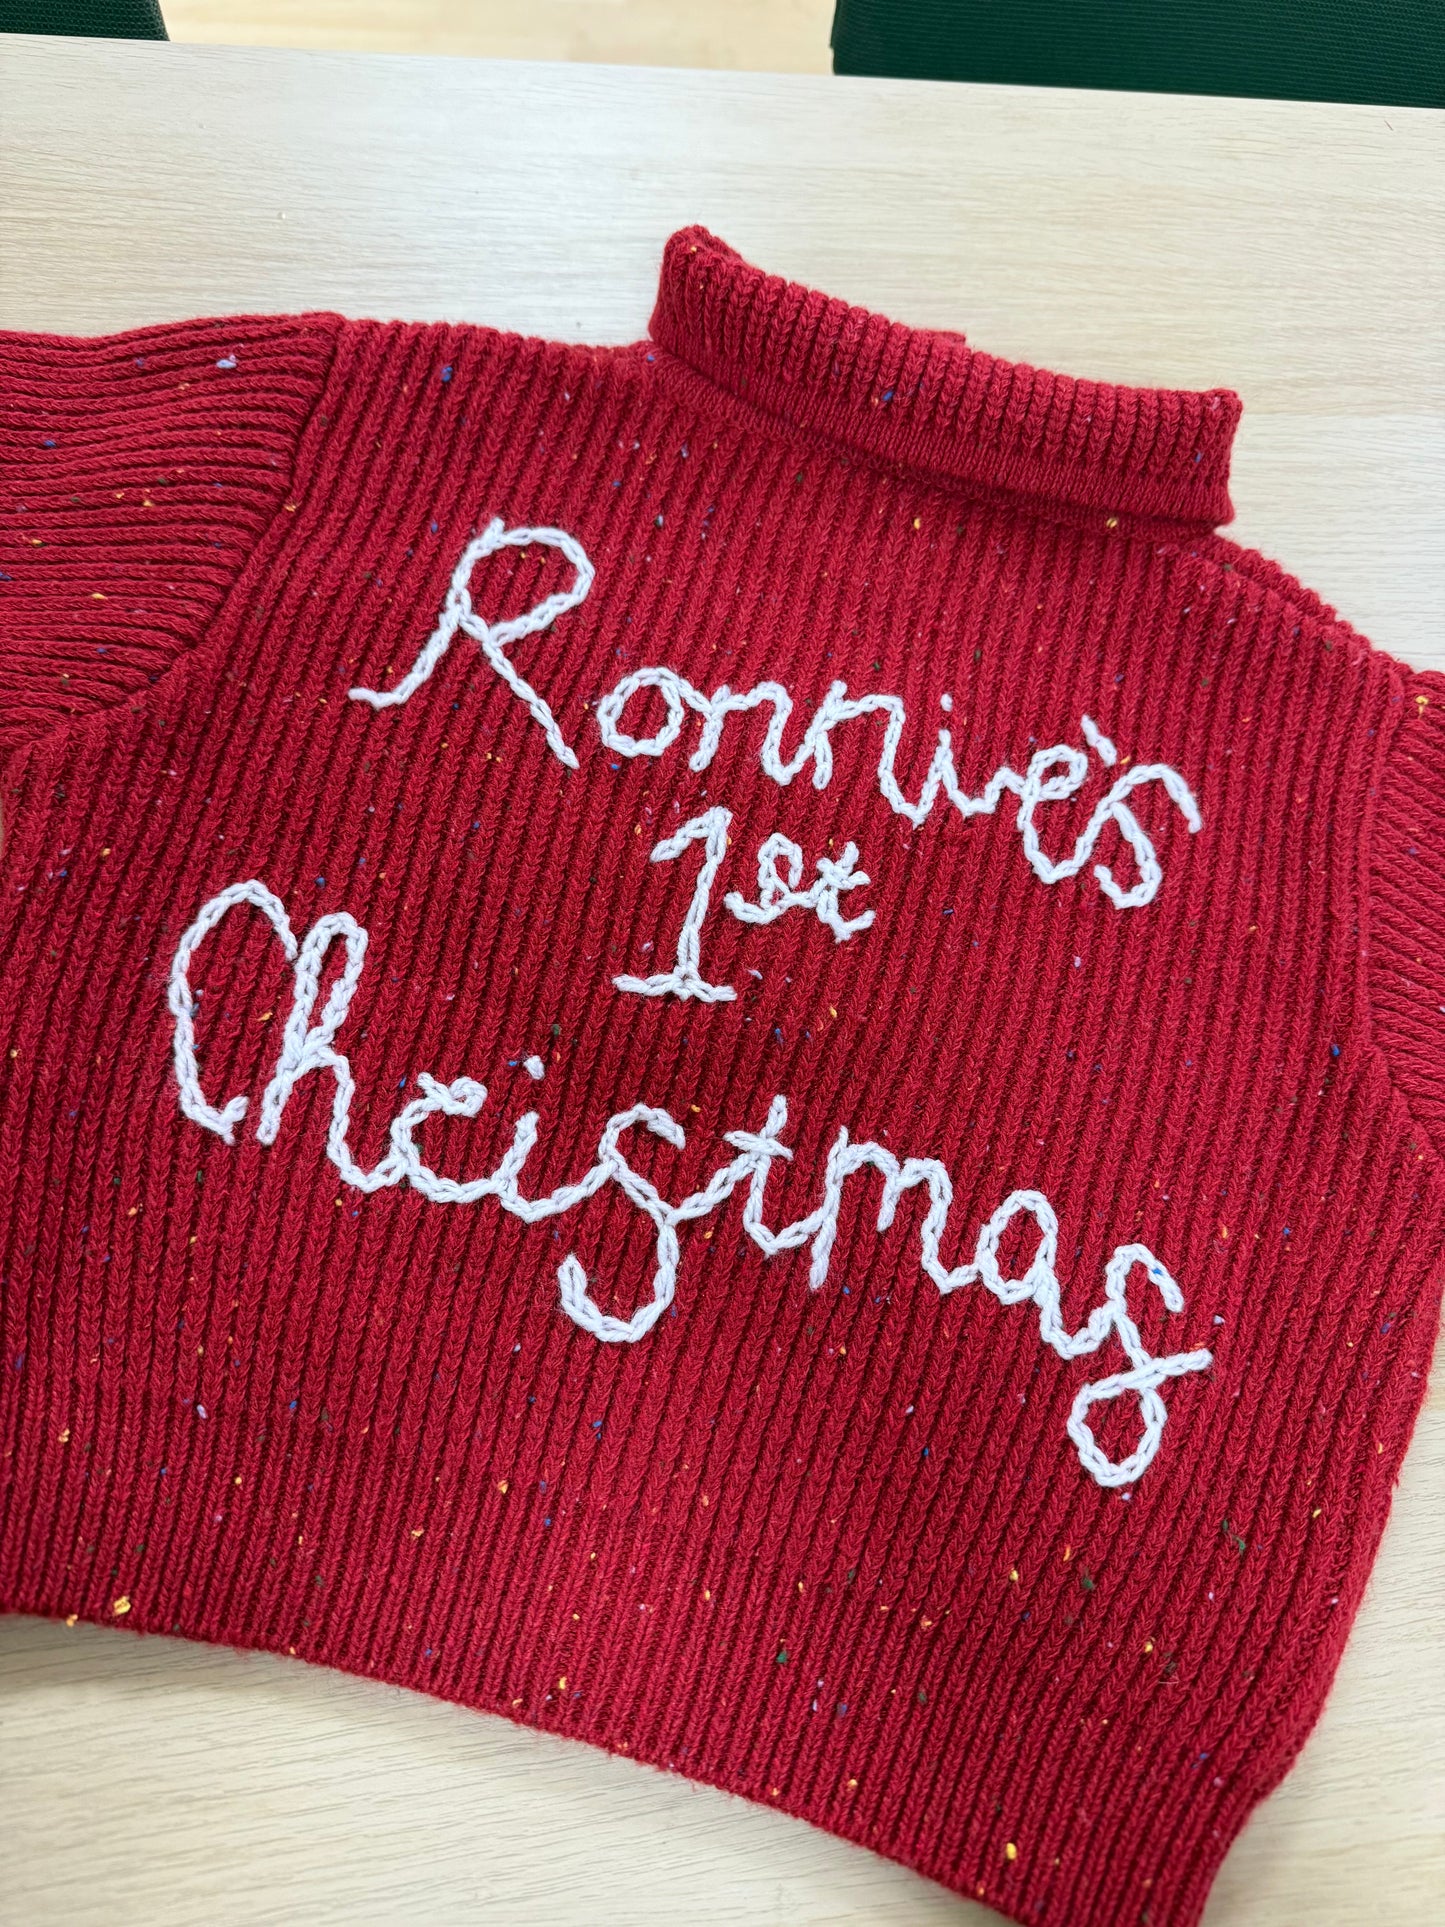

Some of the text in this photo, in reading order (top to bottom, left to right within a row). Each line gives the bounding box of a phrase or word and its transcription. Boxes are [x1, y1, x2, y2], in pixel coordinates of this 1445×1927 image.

[348, 517, 1202, 910] Ronnie's
[612, 806, 876, 1004] 1st
[167, 879, 1213, 1488] Christmas
